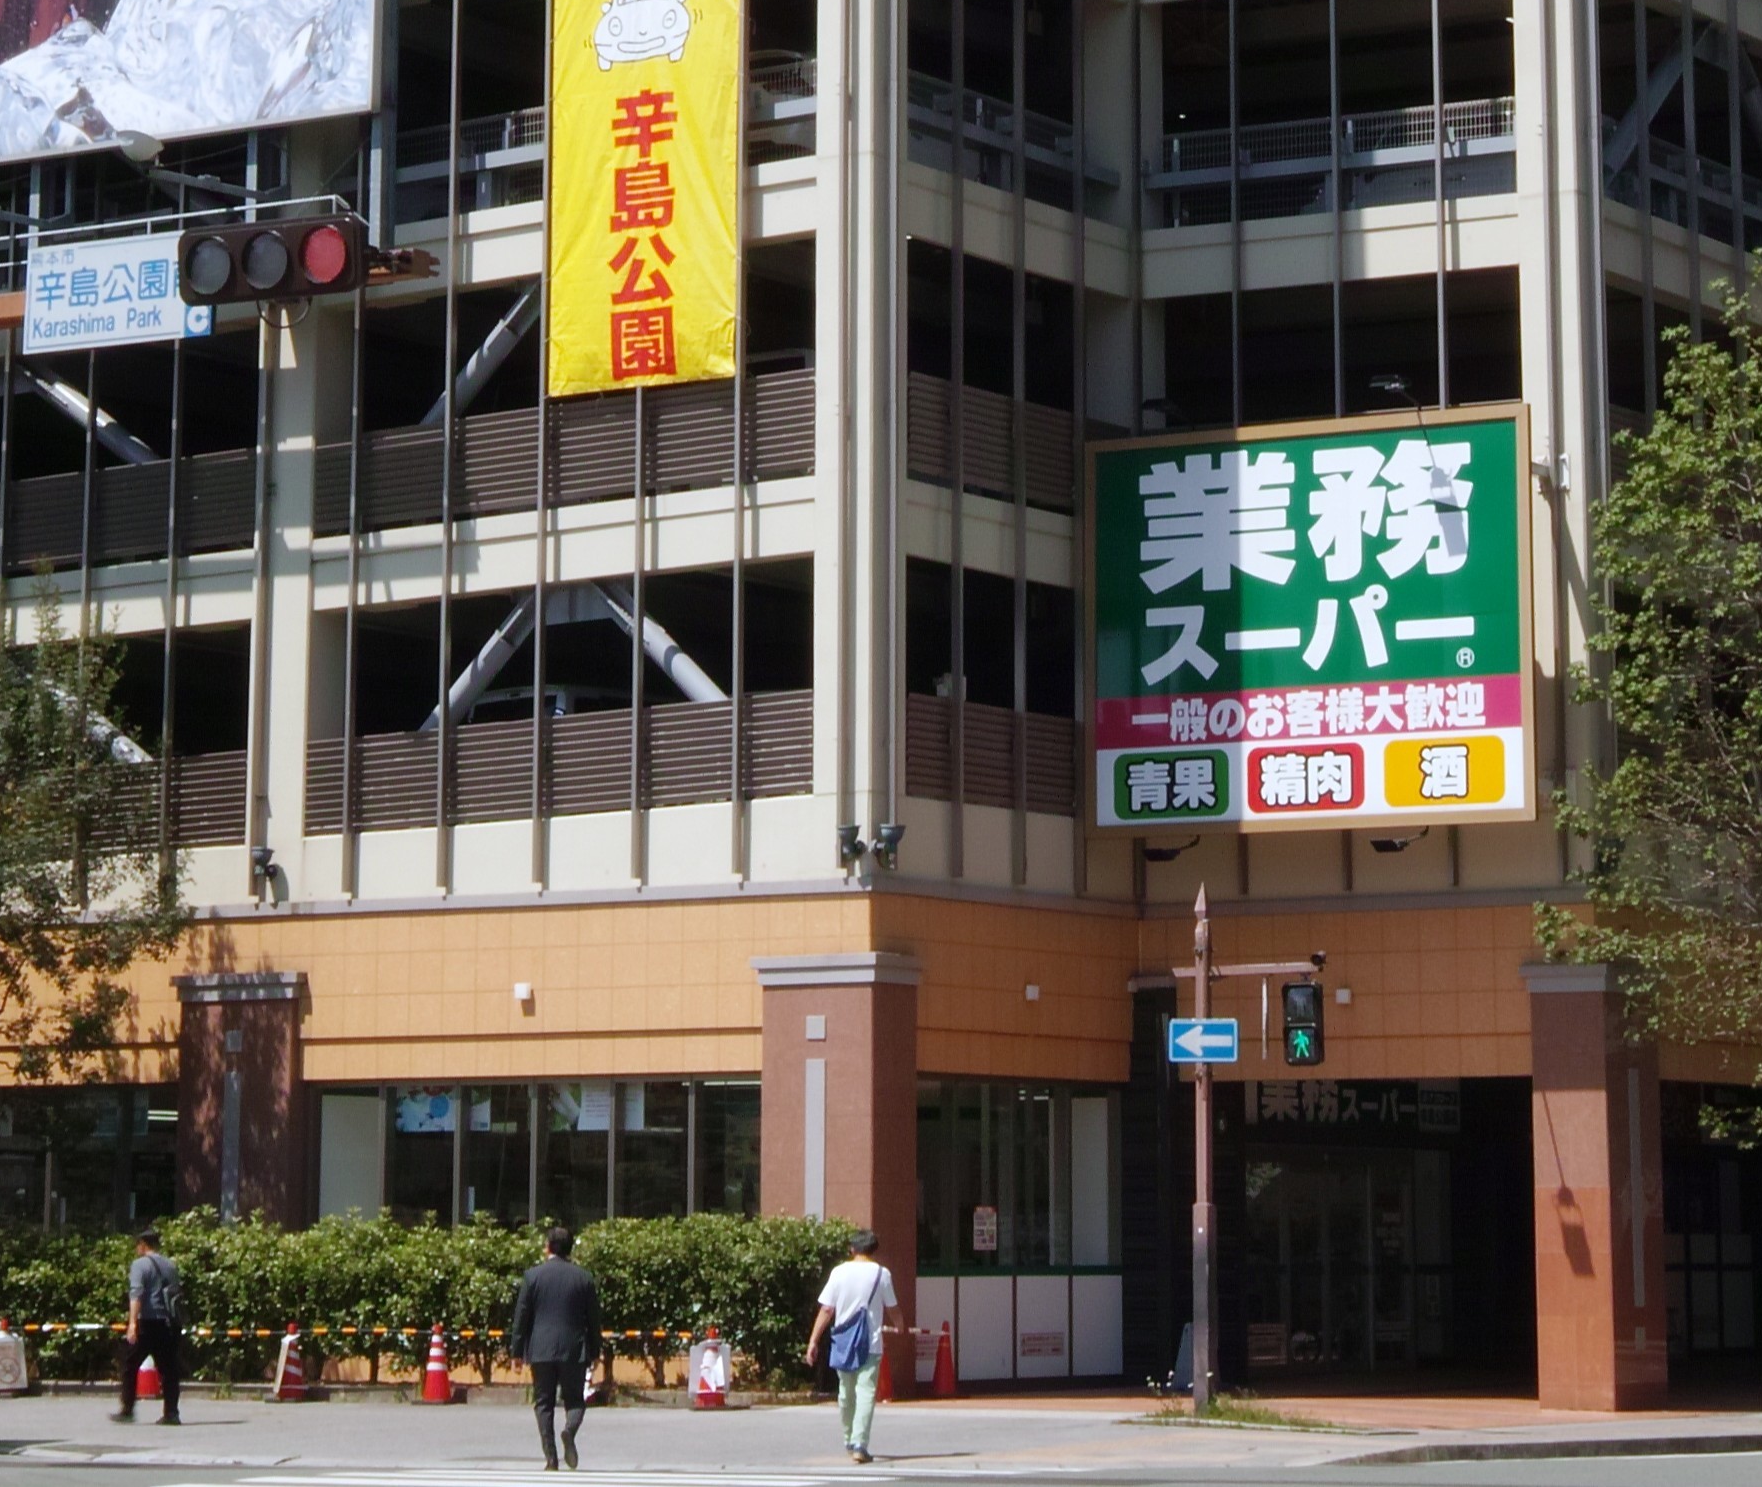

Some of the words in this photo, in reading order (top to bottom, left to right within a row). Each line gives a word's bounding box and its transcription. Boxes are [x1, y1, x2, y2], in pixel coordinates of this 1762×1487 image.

[607, 88, 678, 381] 辛島公園
[35, 257, 182, 313] 辛島公園
[31, 313, 116, 340] Karashima
[126, 304, 163, 330] Park
[1138, 439, 1474, 596] 業務
[1140, 583, 1476, 687] スーパー
[1131, 681, 1486, 743] 一般のお客様大歓迎
[1127, 758, 1217, 812] 青果
[1260, 751, 1352, 806] 精肉
[1419, 745, 1470, 800] 酒
